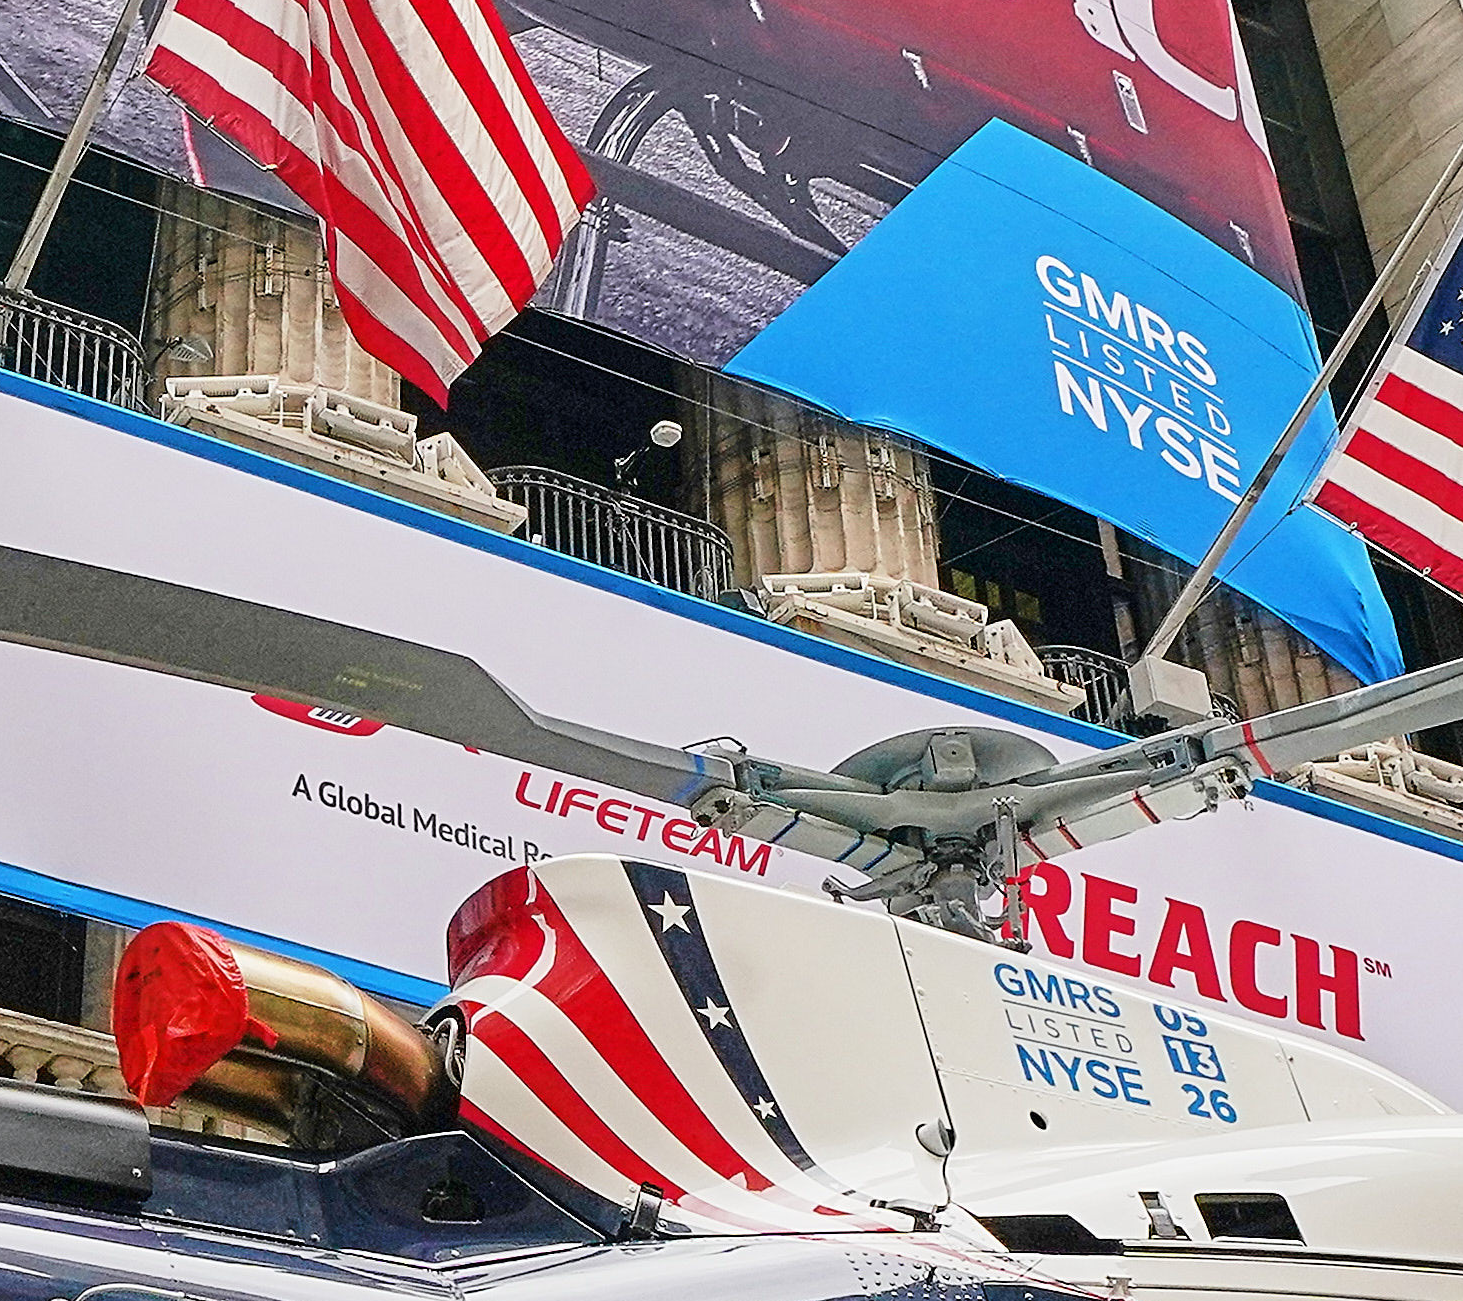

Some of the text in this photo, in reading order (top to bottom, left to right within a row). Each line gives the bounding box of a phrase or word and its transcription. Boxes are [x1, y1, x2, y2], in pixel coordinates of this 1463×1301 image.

[1034, 254, 1217, 387] GMRS
[1044, 313, 1232, 437] LISTED
[1053, 360, 1243, 504] NYSE
[291, 773, 314, 803] A
[318, 781, 406, 829] Global
[413, 807, 517, 863] Medical
[514, 771, 772, 878] LIFETEAM
[993, 962, 1209, 1039] GMRS 05
[1000, 860, 1367, 1043] REACH
[1004, 1008, 1224, 1081] LISTED 13
[1016, 1043, 1238, 1125] NYSE 26
